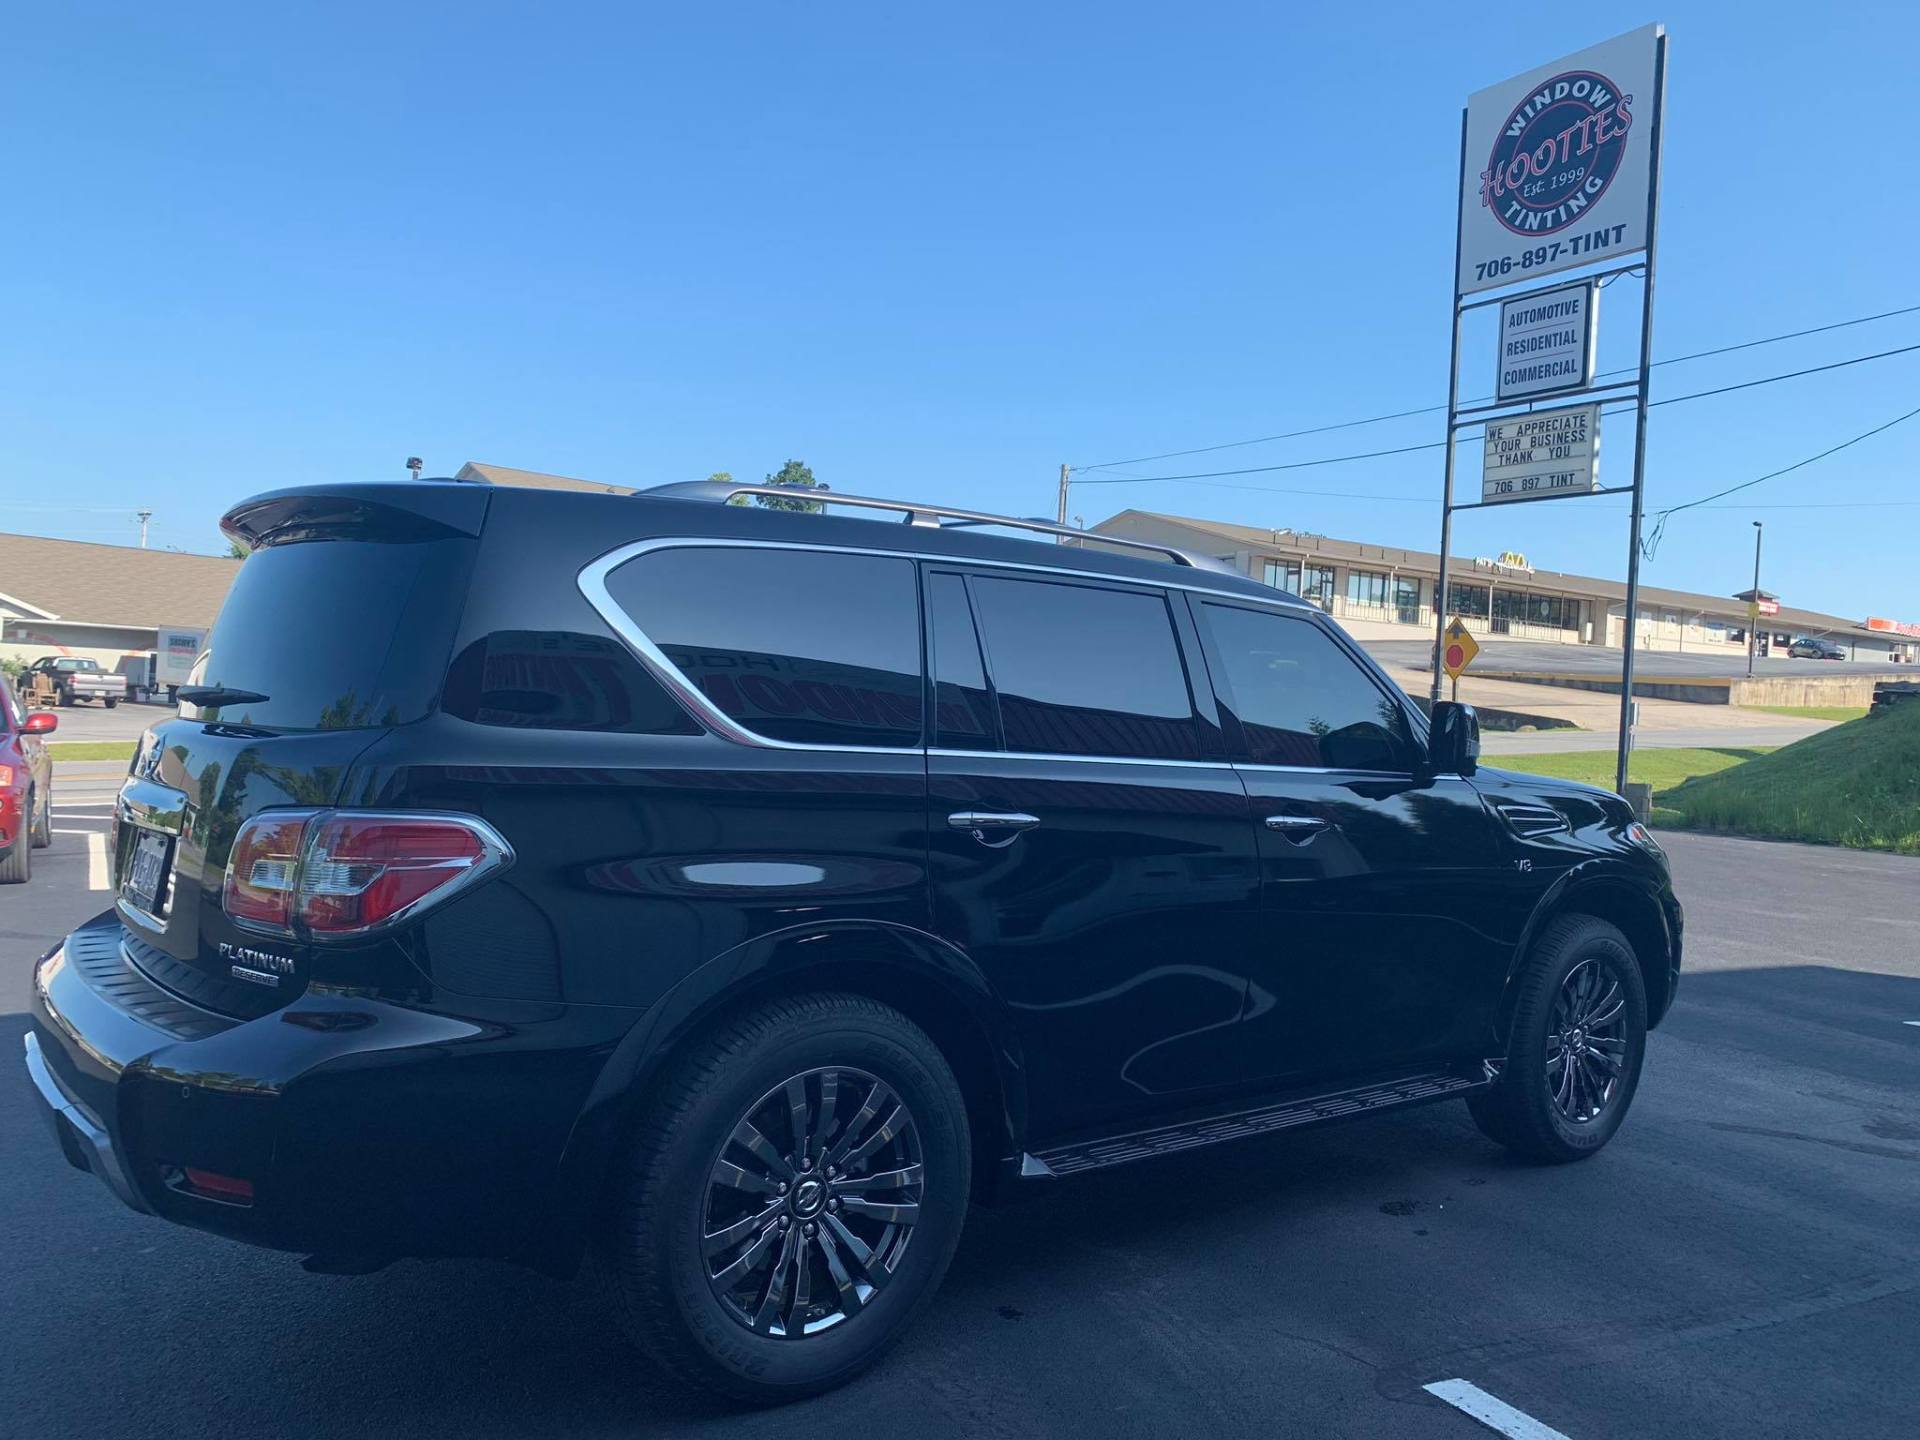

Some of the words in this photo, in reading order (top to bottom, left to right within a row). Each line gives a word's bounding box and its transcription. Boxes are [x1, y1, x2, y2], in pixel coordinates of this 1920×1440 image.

[1506, 79, 1612, 138] WINDOW
[1479, 94, 1633, 207] HOOTIES
[1523, 179, 1545, 198] Est.
[1550, 167, 1585, 189] 1999
[1504, 175, 1603, 231] TINTING
[1475, 223, 1627, 281] 706-897-TINT
[1508, 299, 1580, 328] AUTOMOTIVE
[1506, 329, 1577, 357] RESIDENTIAL
[1504, 359, 1577, 386] COMMERCIAL
[1488, 428, 1503, 440] WE
[1516, 414, 1586, 437] APPRECIATE
[1493, 437, 1521, 453] YOUR
[1530, 429, 1586, 448] BUSINESS
[1498, 452, 1533, 465] THANK
[1549, 445, 1571, 460] YOU
[1495, 480, 1513, 494] 706
[1521, 477, 1540, 490] 897
[1549, 473, 1576, 488] TINT
[219, 942, 295, 973] PLATINUM
